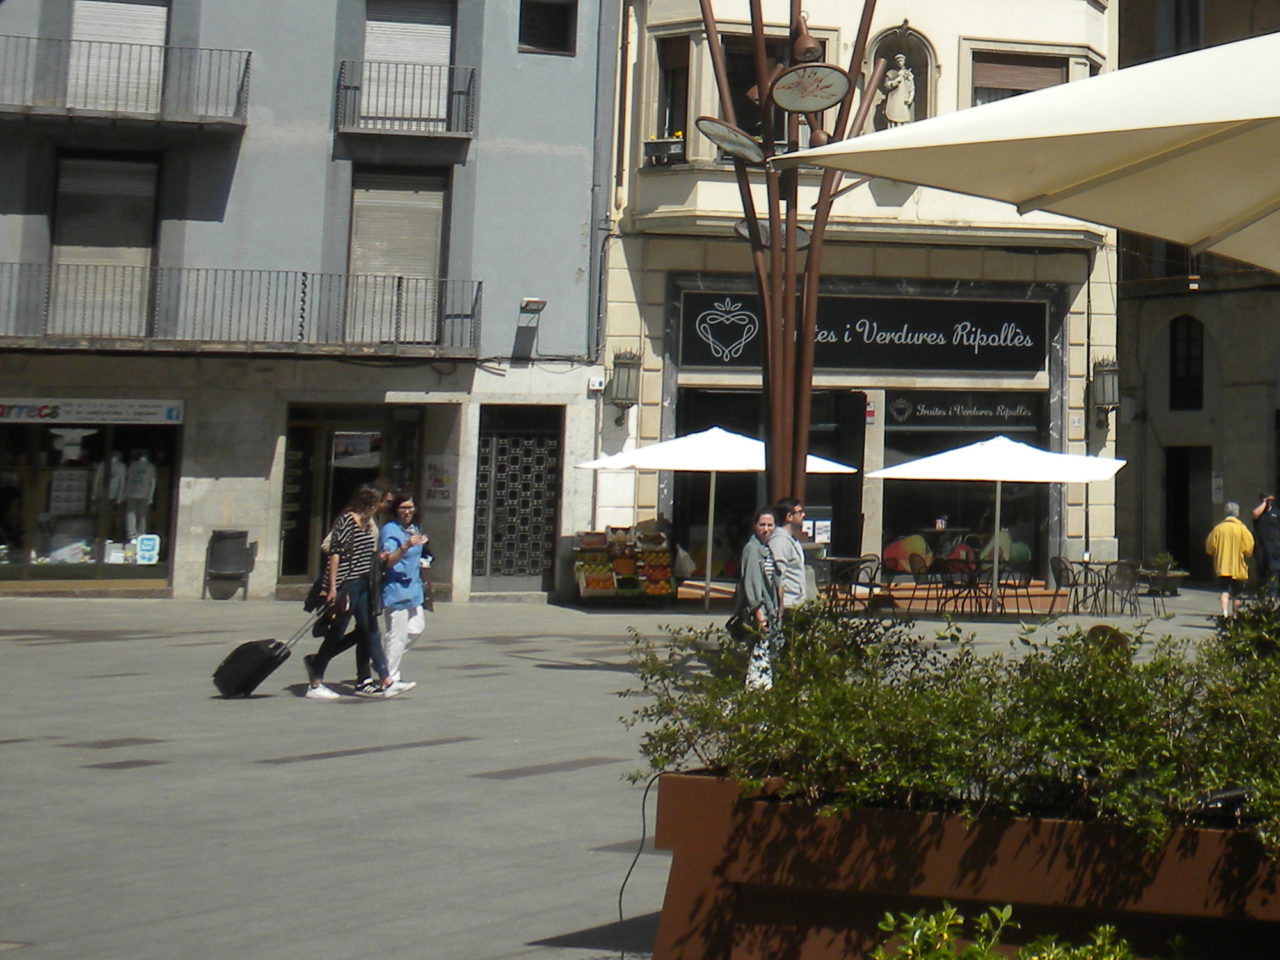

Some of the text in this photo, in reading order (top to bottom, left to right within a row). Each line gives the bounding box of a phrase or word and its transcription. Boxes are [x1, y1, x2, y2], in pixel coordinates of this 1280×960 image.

[844, 324, 852, 343] i
[855, 319, 947, 345] Verdures
[953, 321, 1033, 354] Ripollès
[954, 404, 993, 416] Verdures
